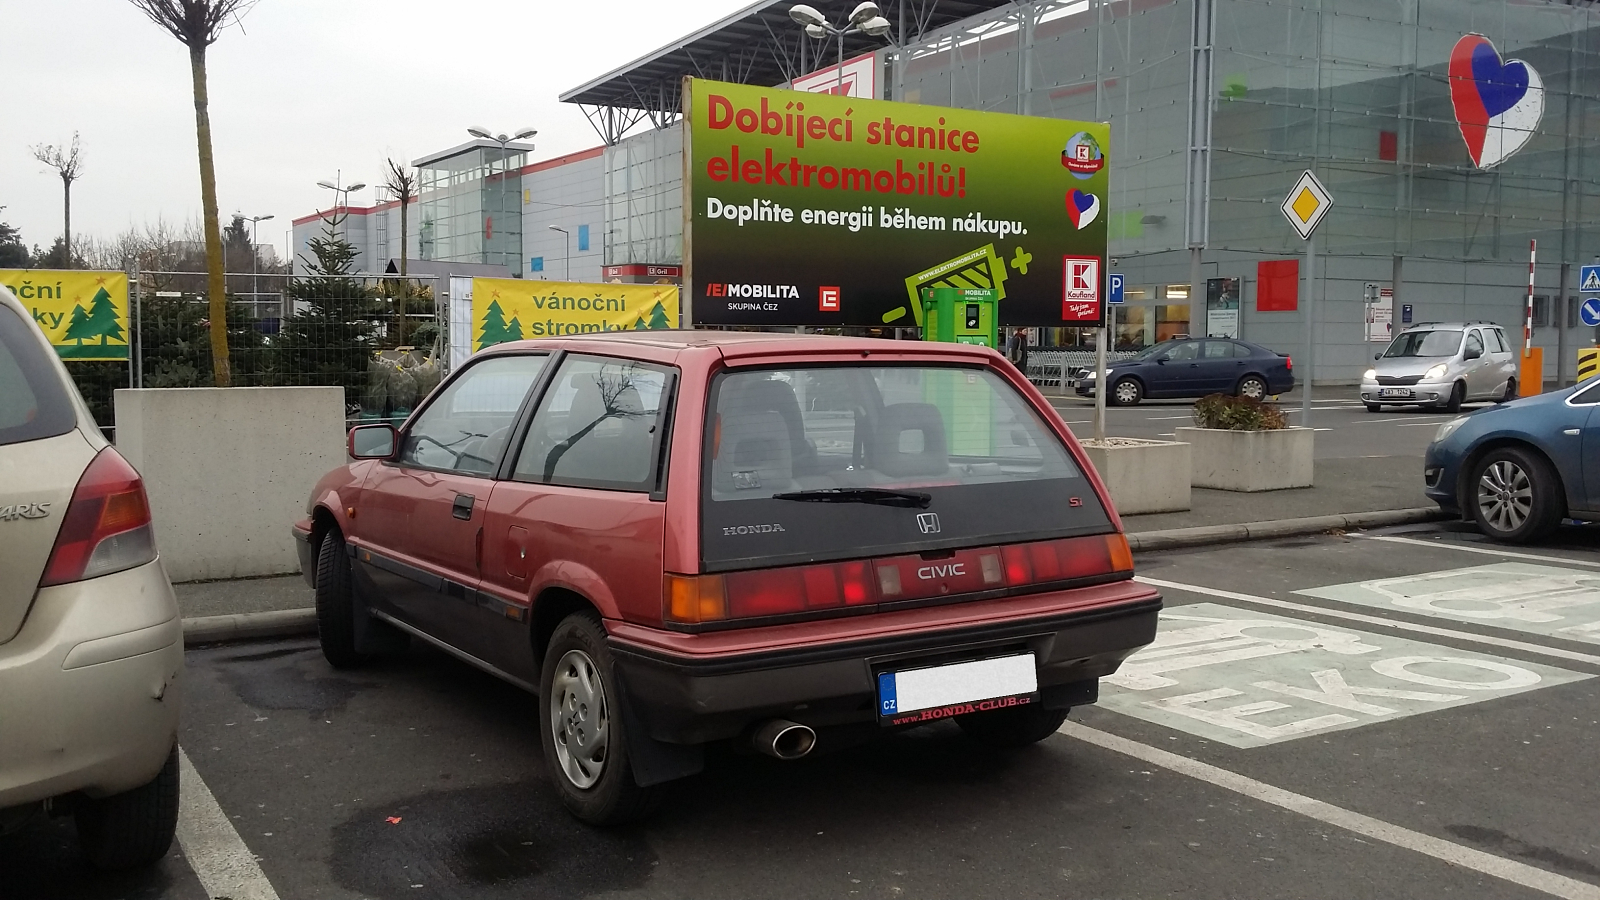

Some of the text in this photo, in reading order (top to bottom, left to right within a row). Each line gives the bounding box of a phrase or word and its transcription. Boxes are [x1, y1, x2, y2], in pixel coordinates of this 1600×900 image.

[708, 94, 980, 153] Dobíjecí stanice
[706, 145, 966, 199] elektromobilů!
[707, 197, 1028, 239] Doplňte energii během nákupu.
[1067, 290, 1096, 299] Kaufland
[1112, 277, 1122, 295] P
[532, 291, 626, 311] vánoční
[727, 301, 779, 311] SKUPINA ČEZ
[1069, 497, 1083, 507] Si
[723, 523, 786, 536] HONDA
[917, 563, 966, 580] CIVIC
[883, 699, 896, 710] CZ
[1141, 656, 1542, 740] EKO
